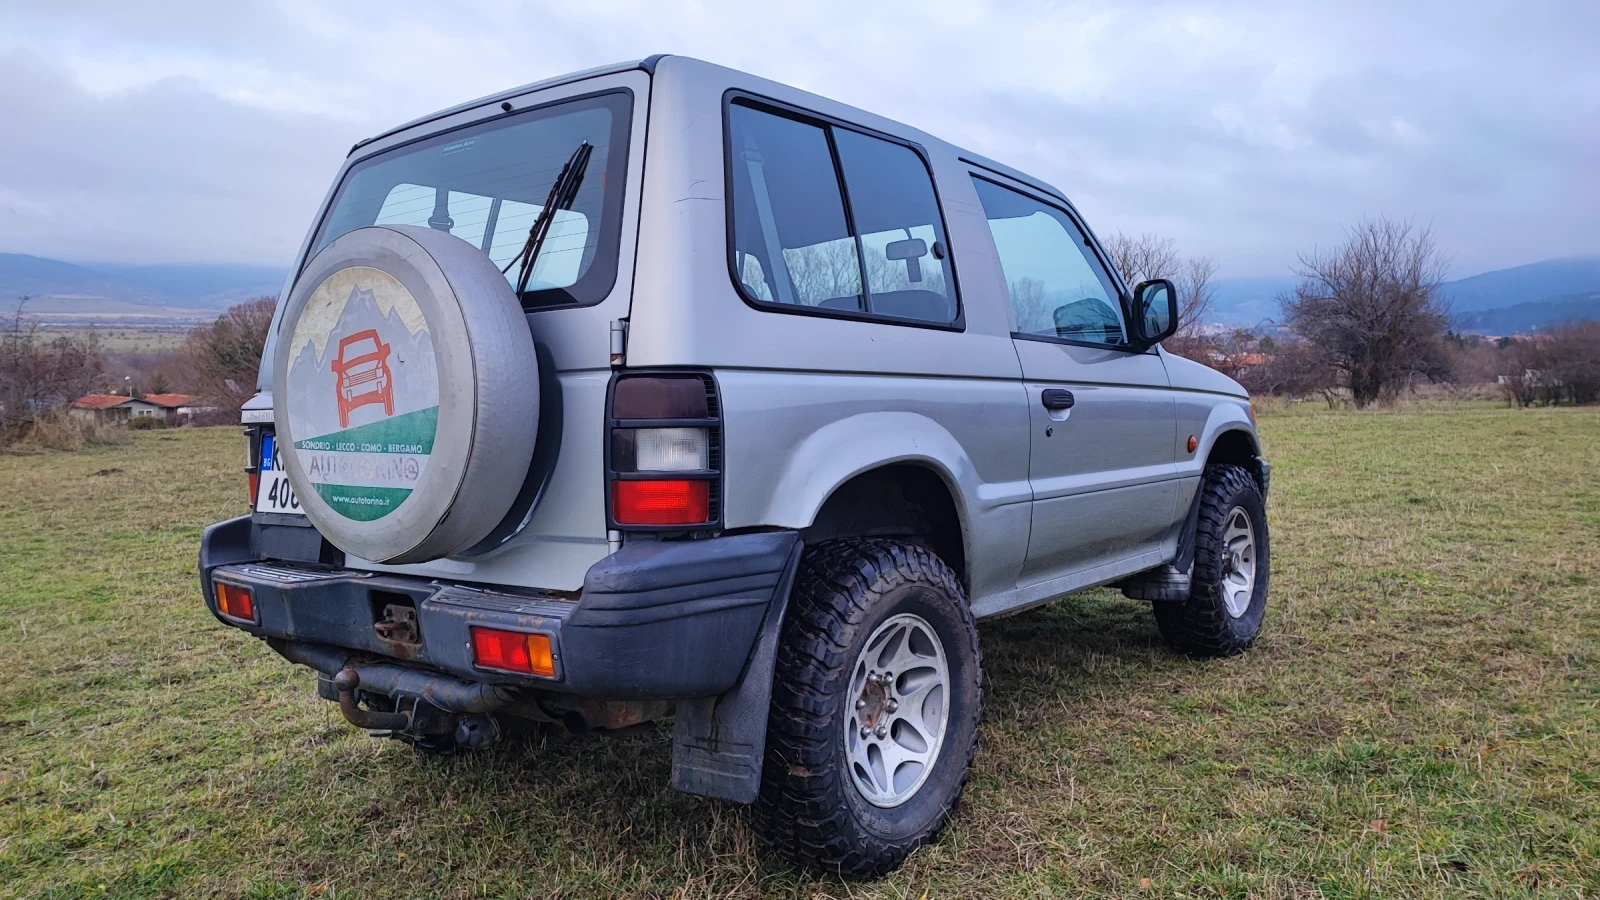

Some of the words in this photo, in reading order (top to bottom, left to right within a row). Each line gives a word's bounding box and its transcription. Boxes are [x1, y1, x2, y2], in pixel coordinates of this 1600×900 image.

[302, 440, 330, 450] SONDRIO
[336, 443, 355, 452] LECCO
[361, 444, 382, 452] COMO
[388, 444, 423, 453] BERGAMO
[271, 440, 285, 471] K
[263, 458, 271, 467] BG
[332, 494, 390, 506] www.autotorino.it
